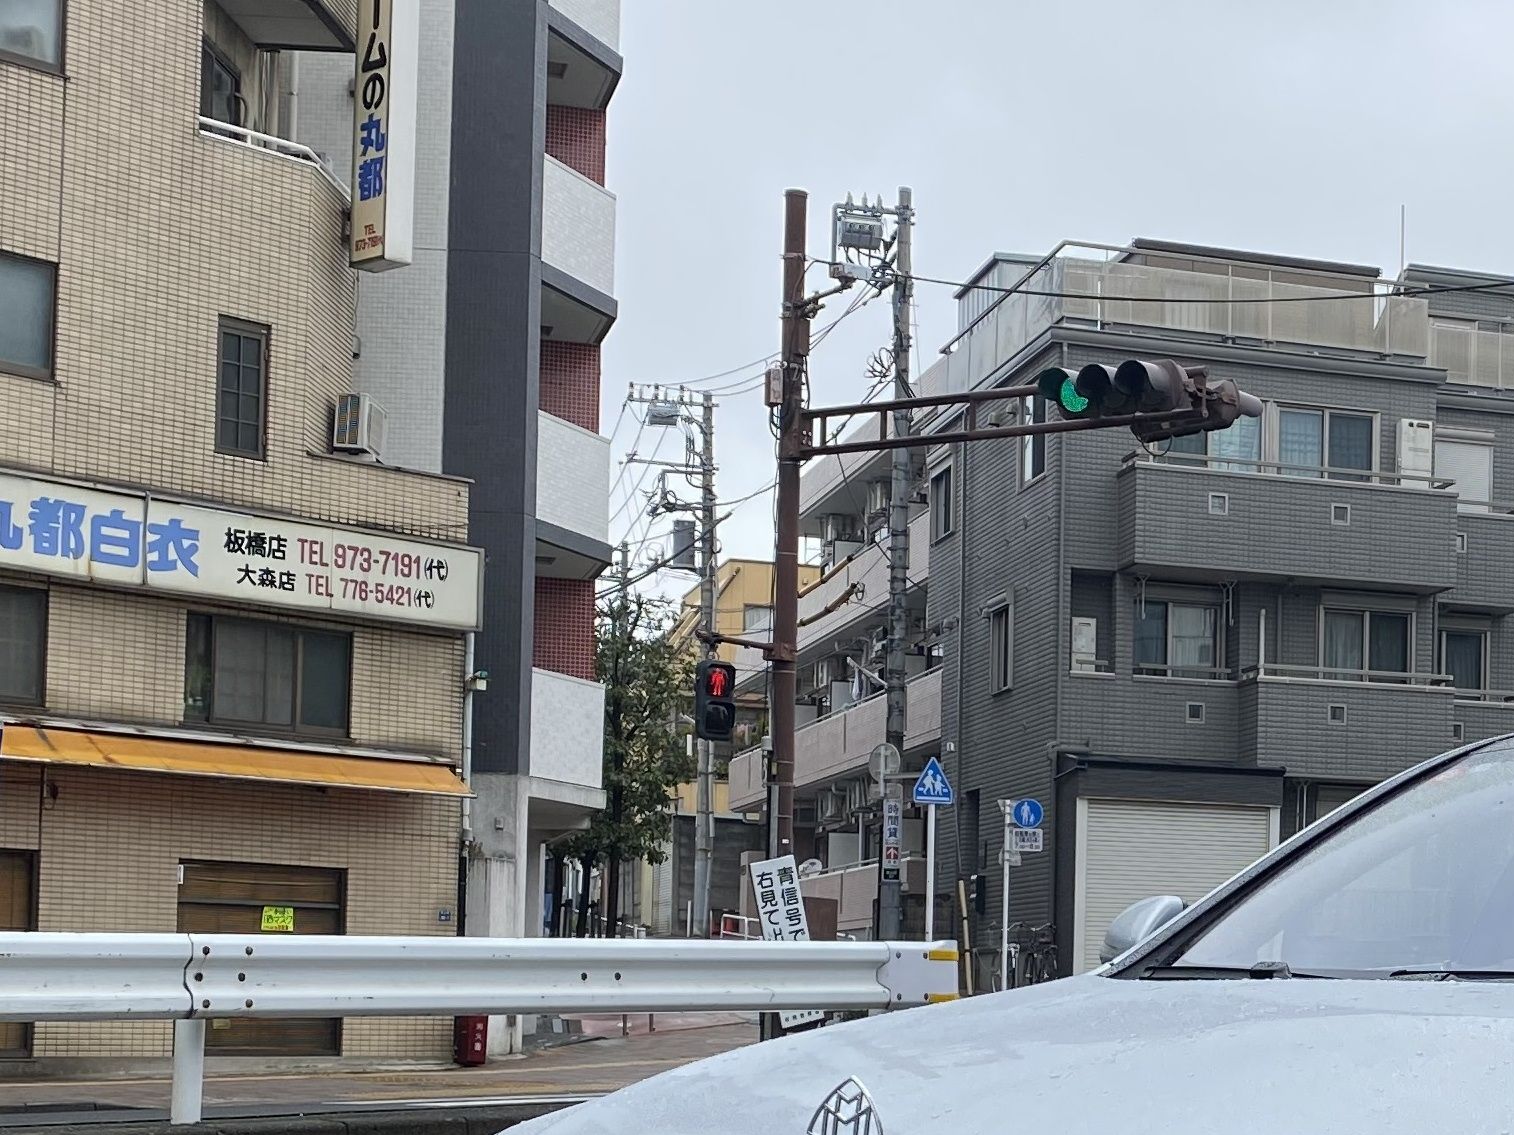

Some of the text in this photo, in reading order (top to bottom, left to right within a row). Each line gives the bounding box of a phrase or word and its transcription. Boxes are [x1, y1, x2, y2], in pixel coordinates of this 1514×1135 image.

[364, 223, 376, 236] TEL
[223, 526, 289, 561] 板橋店
[297, 538, 329, 568] TEL
[236, 563, 297, 592] 大森店
[305, 573, 334, 598] TEL
[777, 866, 805, 941] 青信号で
